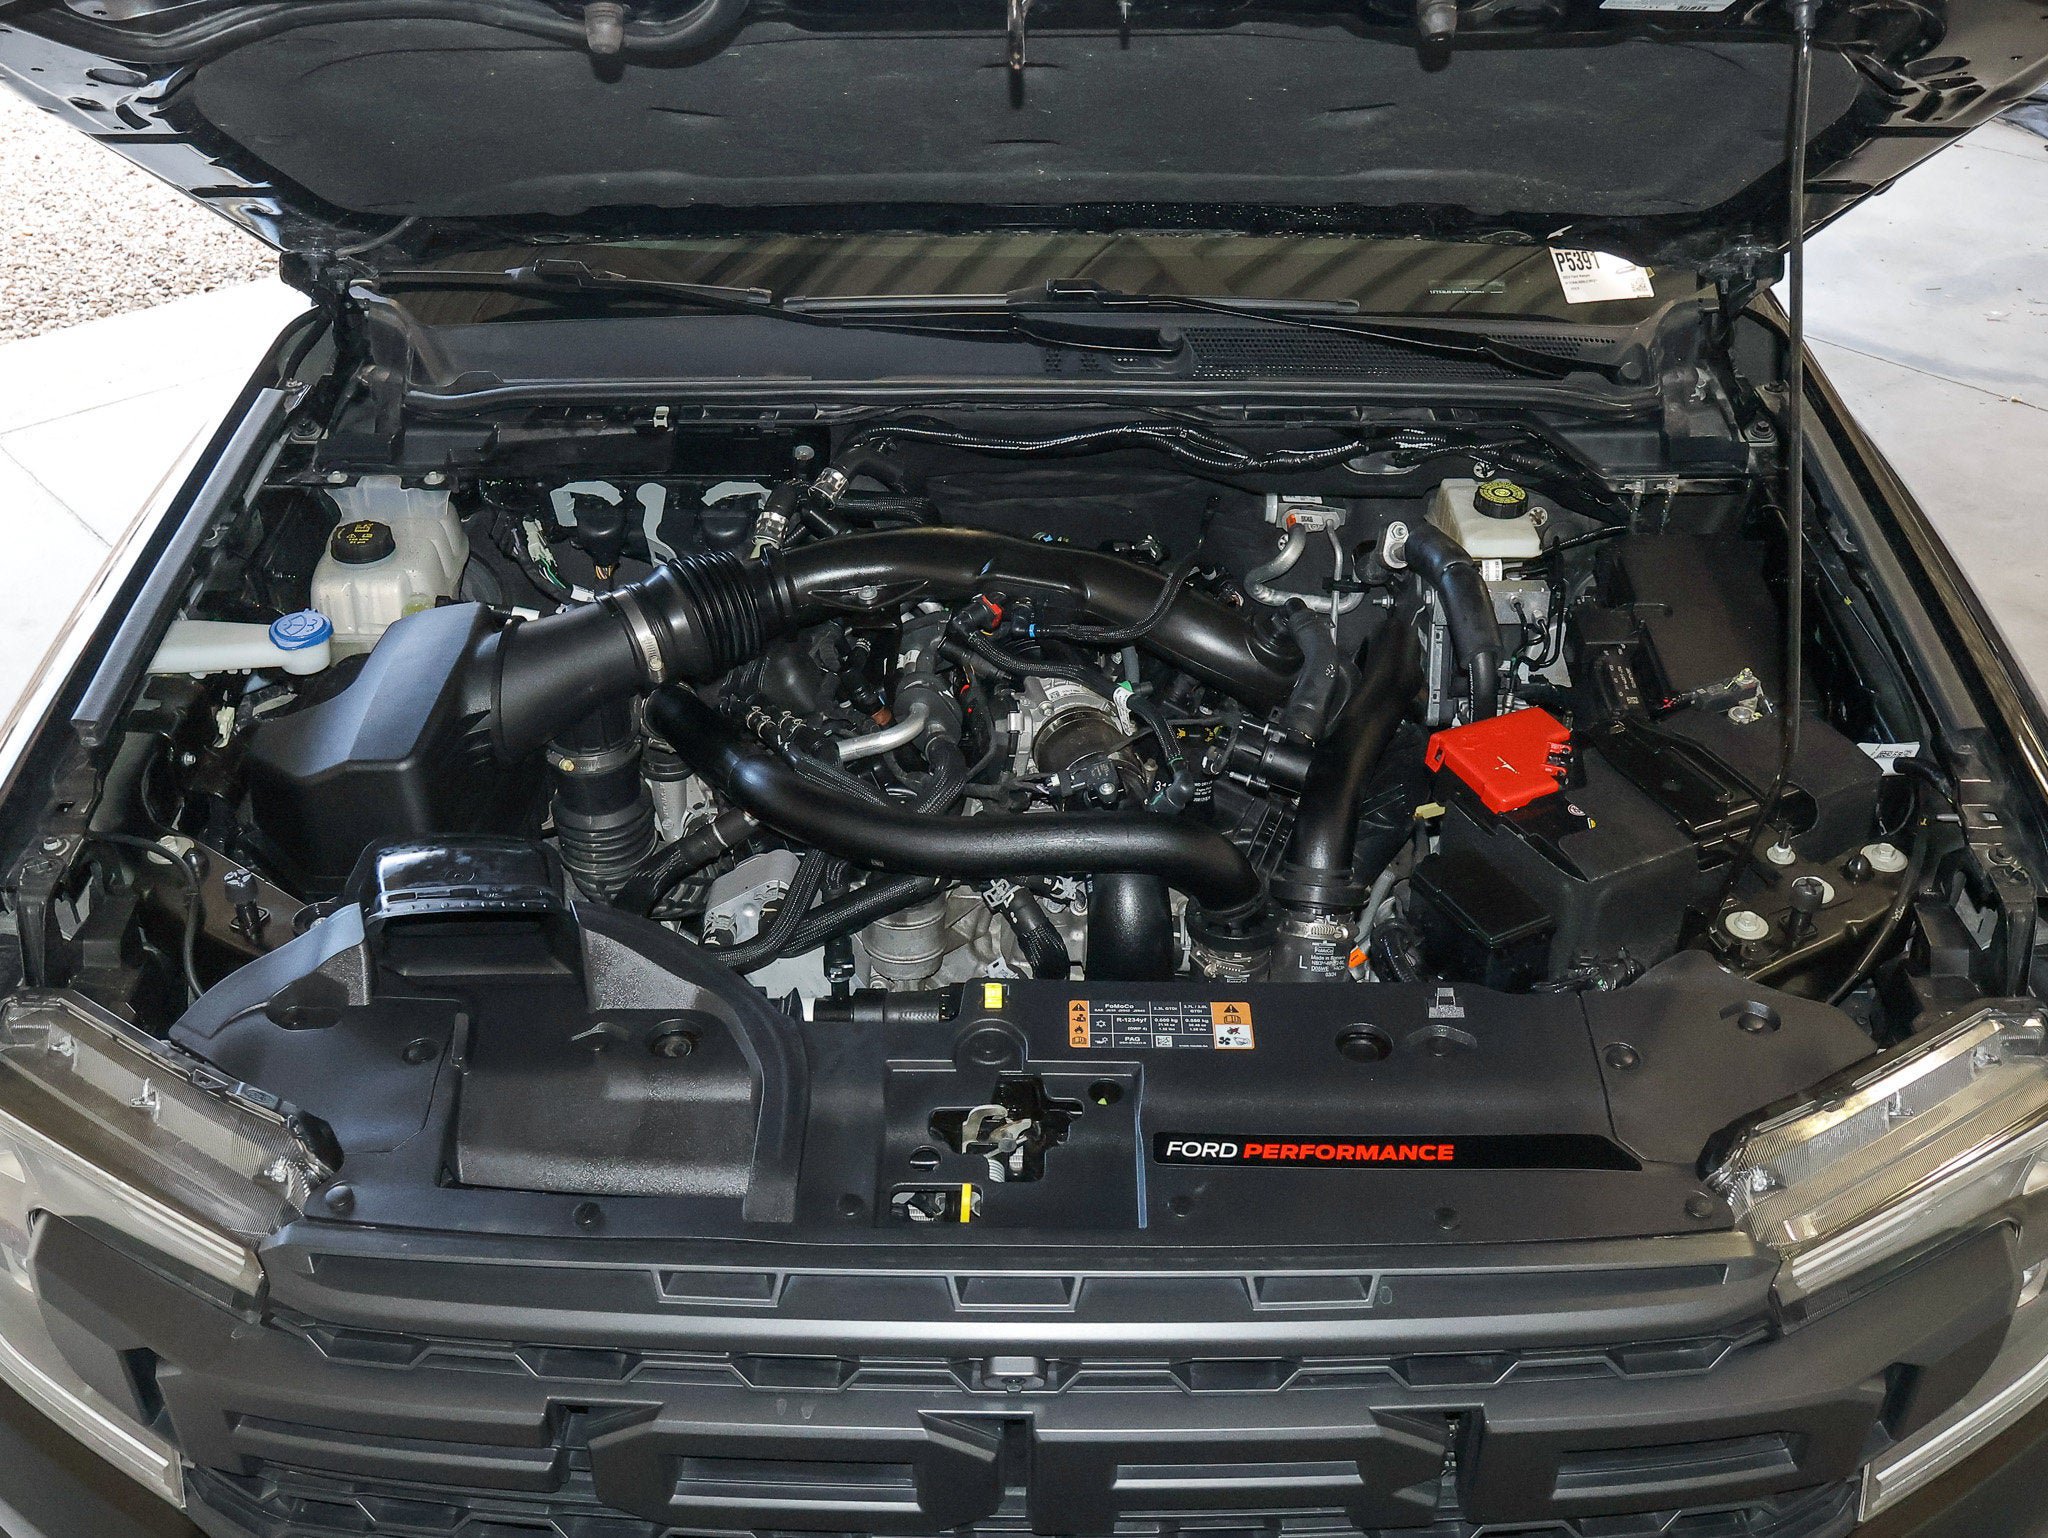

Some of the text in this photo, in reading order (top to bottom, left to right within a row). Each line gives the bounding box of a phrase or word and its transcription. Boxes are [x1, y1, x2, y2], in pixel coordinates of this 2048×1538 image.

[1299, 955, 1307, 969] L
[1166, 1141, 1454, 1161] FORD PERFORMANCE
